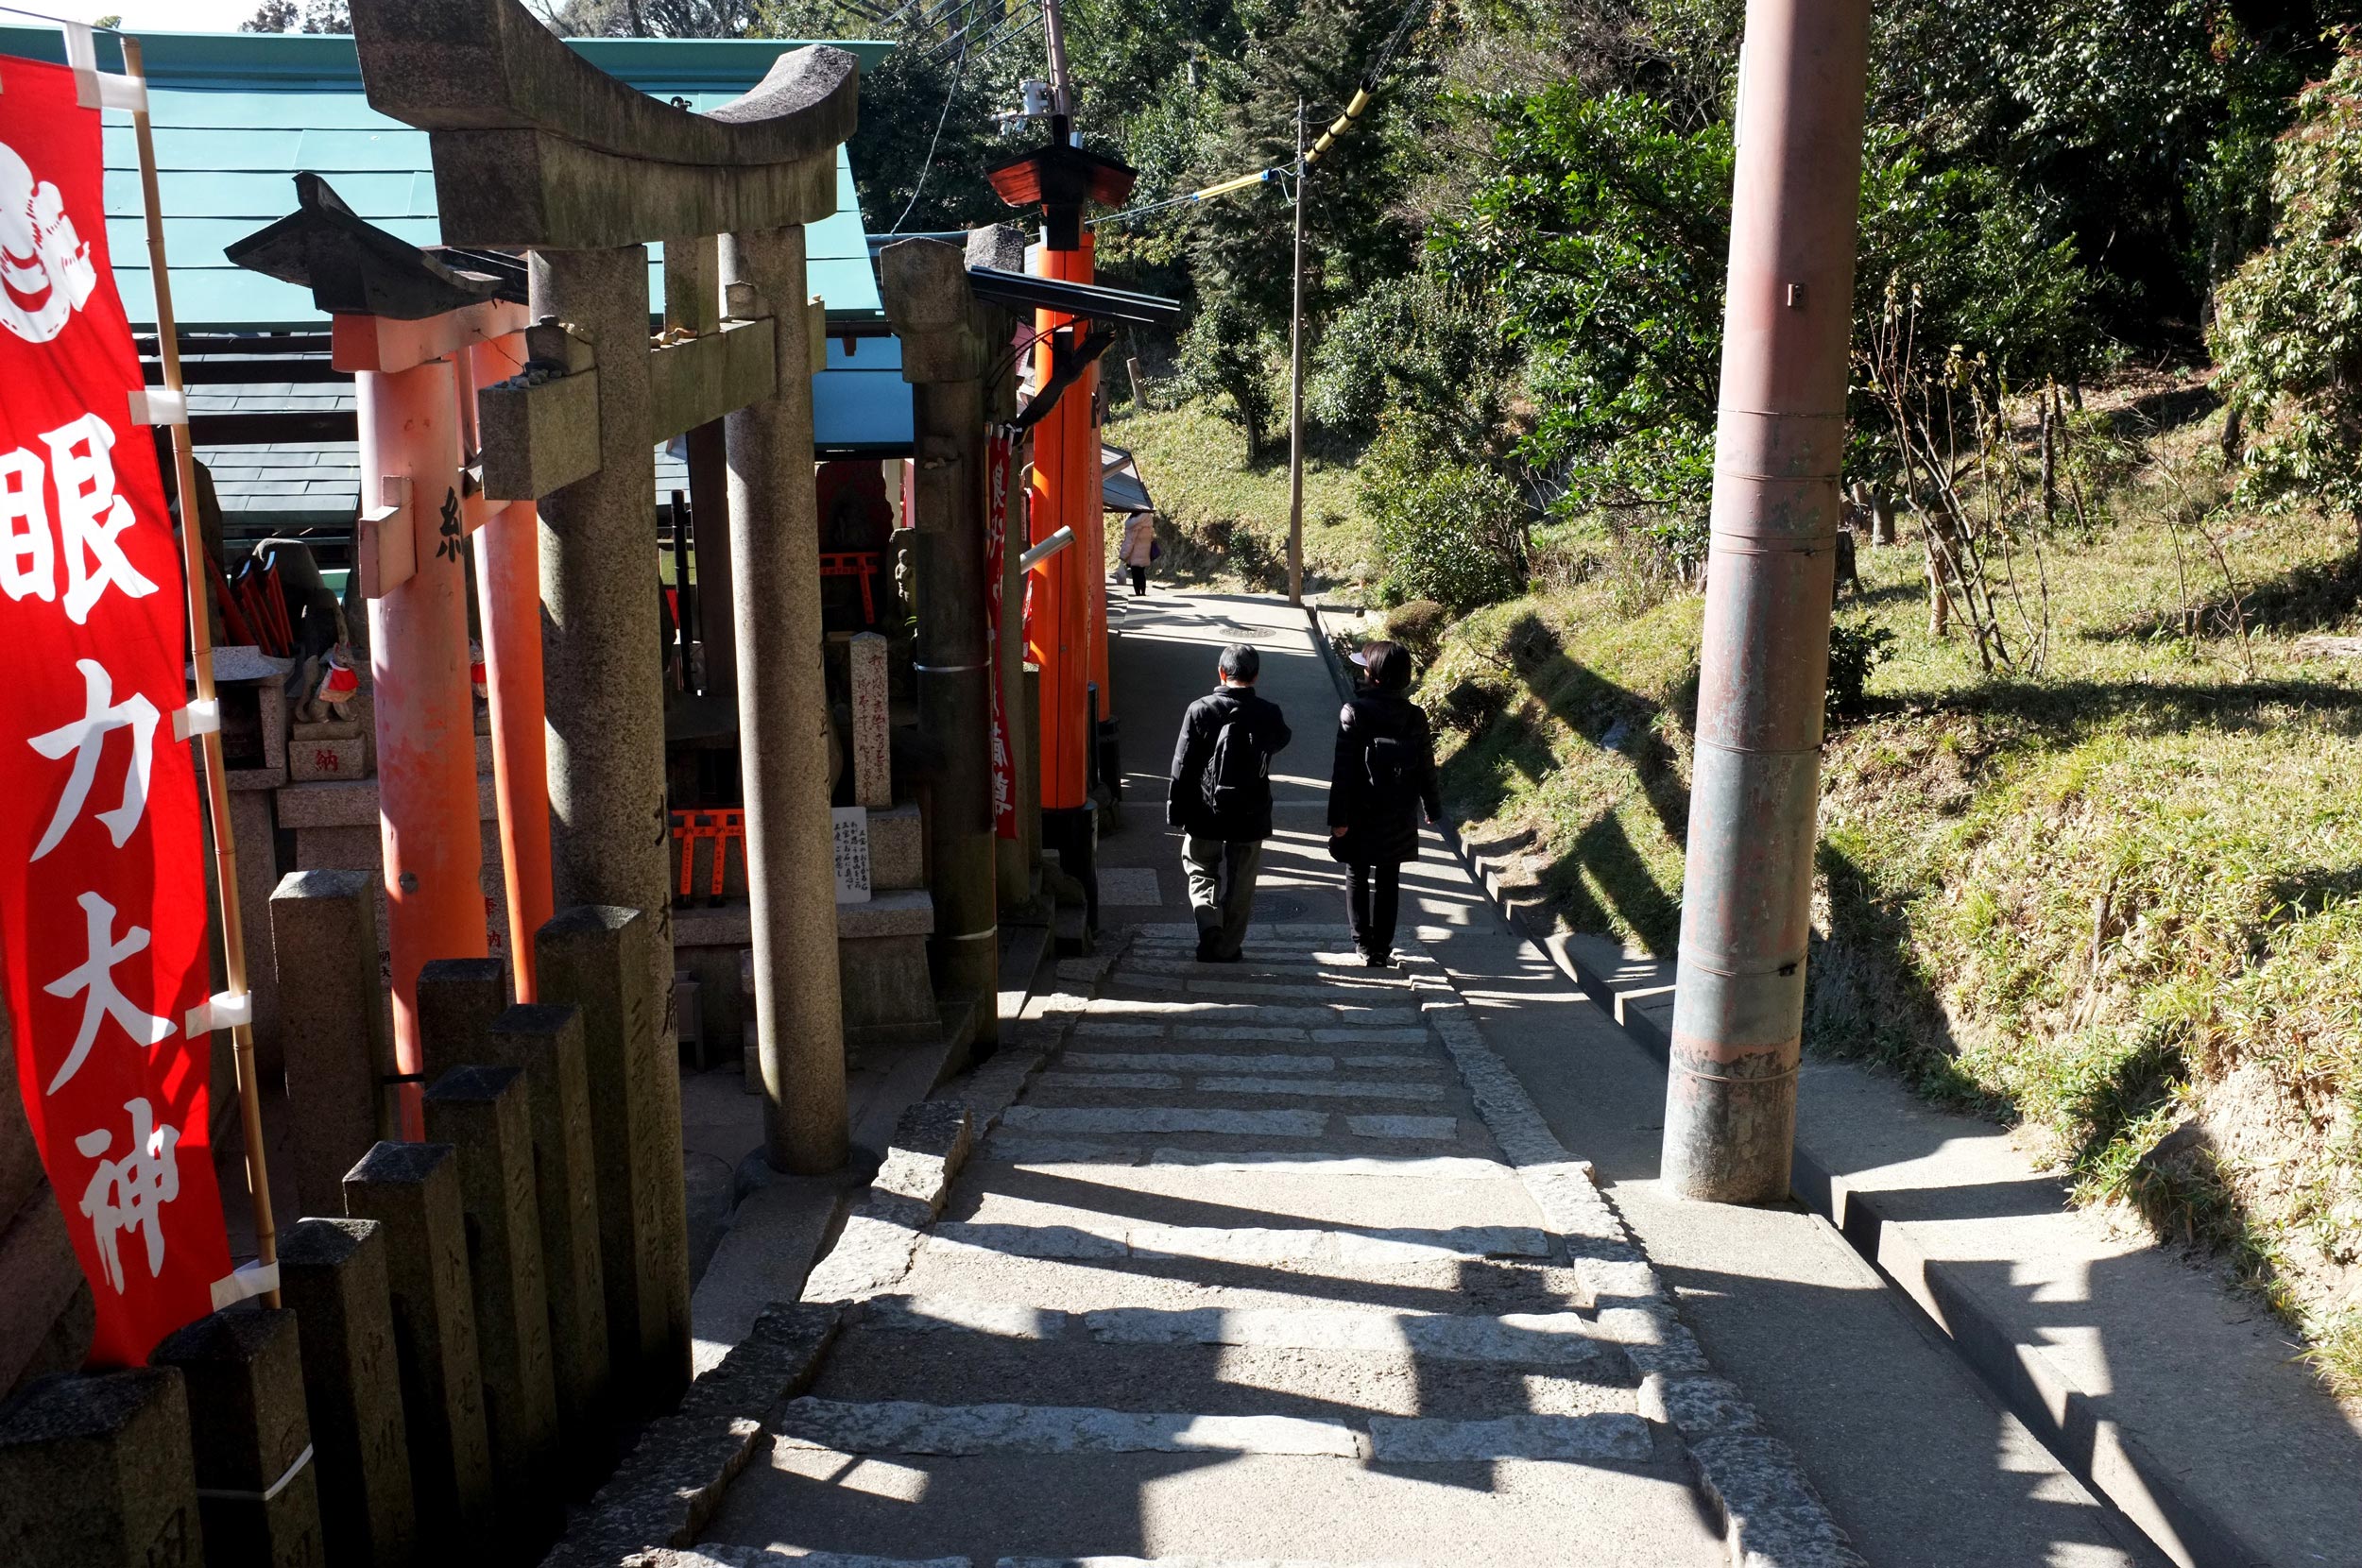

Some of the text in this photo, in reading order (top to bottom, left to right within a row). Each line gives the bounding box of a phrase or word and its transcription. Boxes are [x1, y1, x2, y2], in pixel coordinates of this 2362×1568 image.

[0, 413, 180, 1295] 眼力大神
[315, 748, 338, 773] 納
